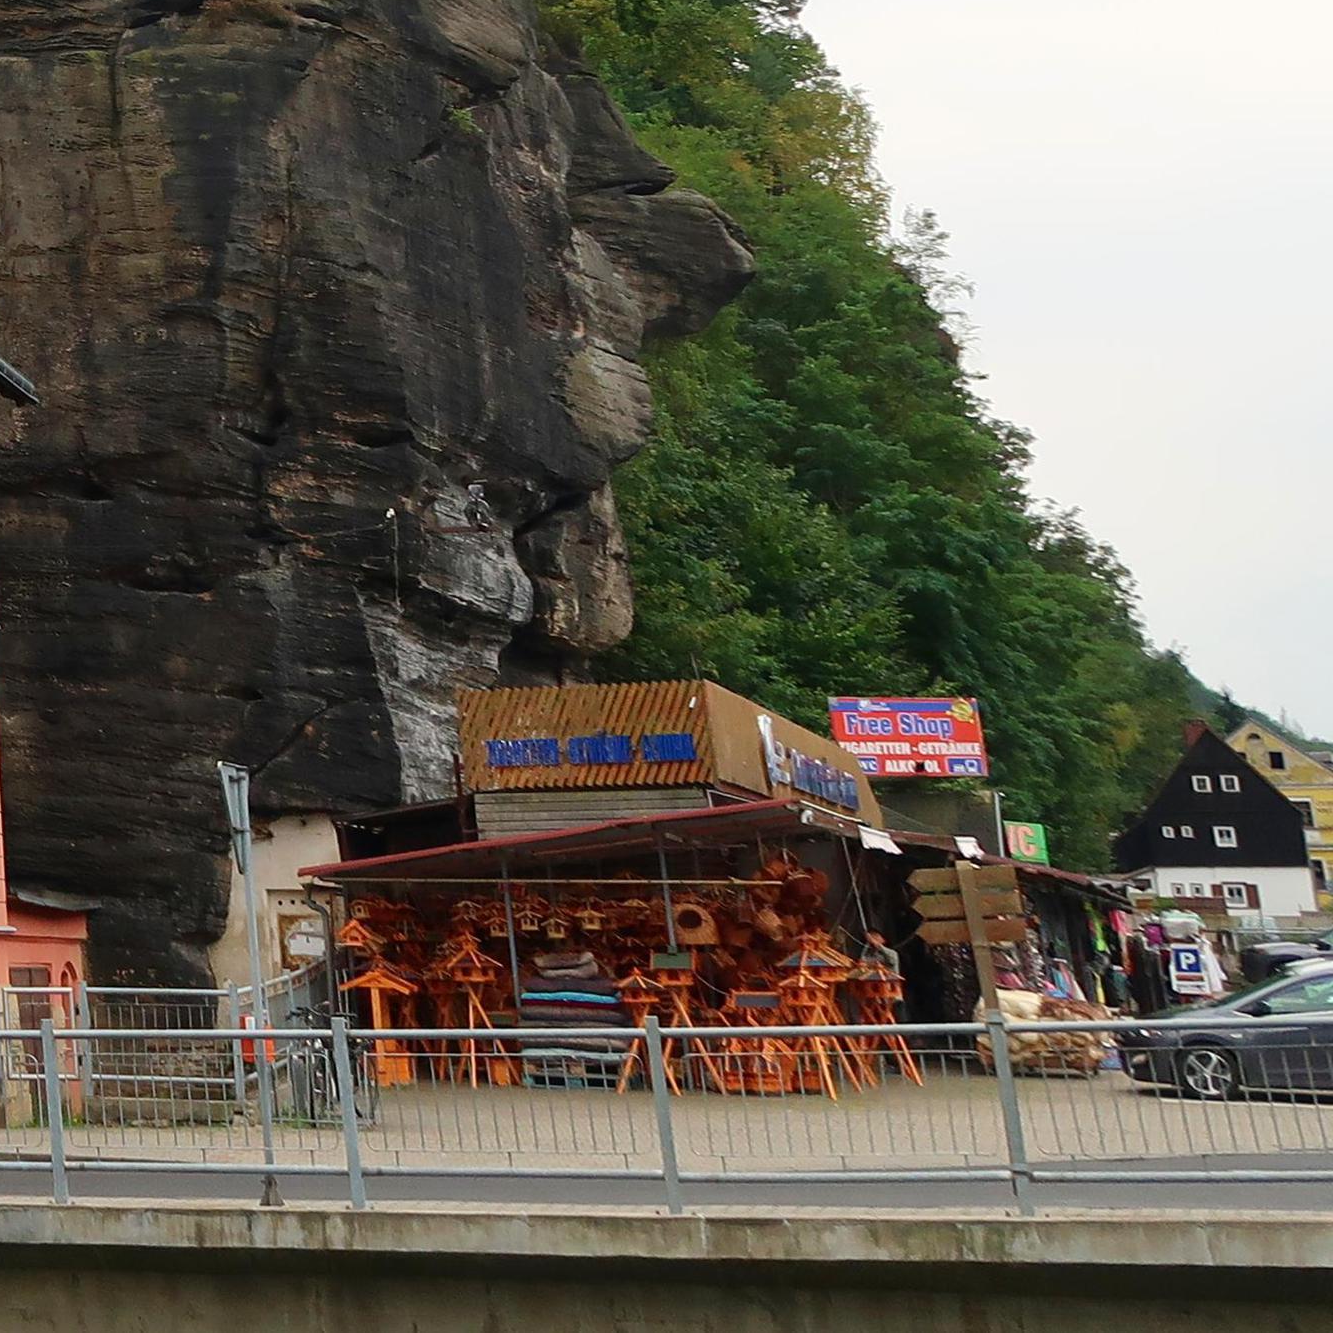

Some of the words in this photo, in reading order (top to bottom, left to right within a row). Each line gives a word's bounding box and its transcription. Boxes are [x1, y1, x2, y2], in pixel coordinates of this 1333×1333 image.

[843, 712, 892, 736] Free
[896, 712, 953, 741] Shop
[885, 759, 941, 773] ALKOOL
[1178, 951, 1197, 971] P
